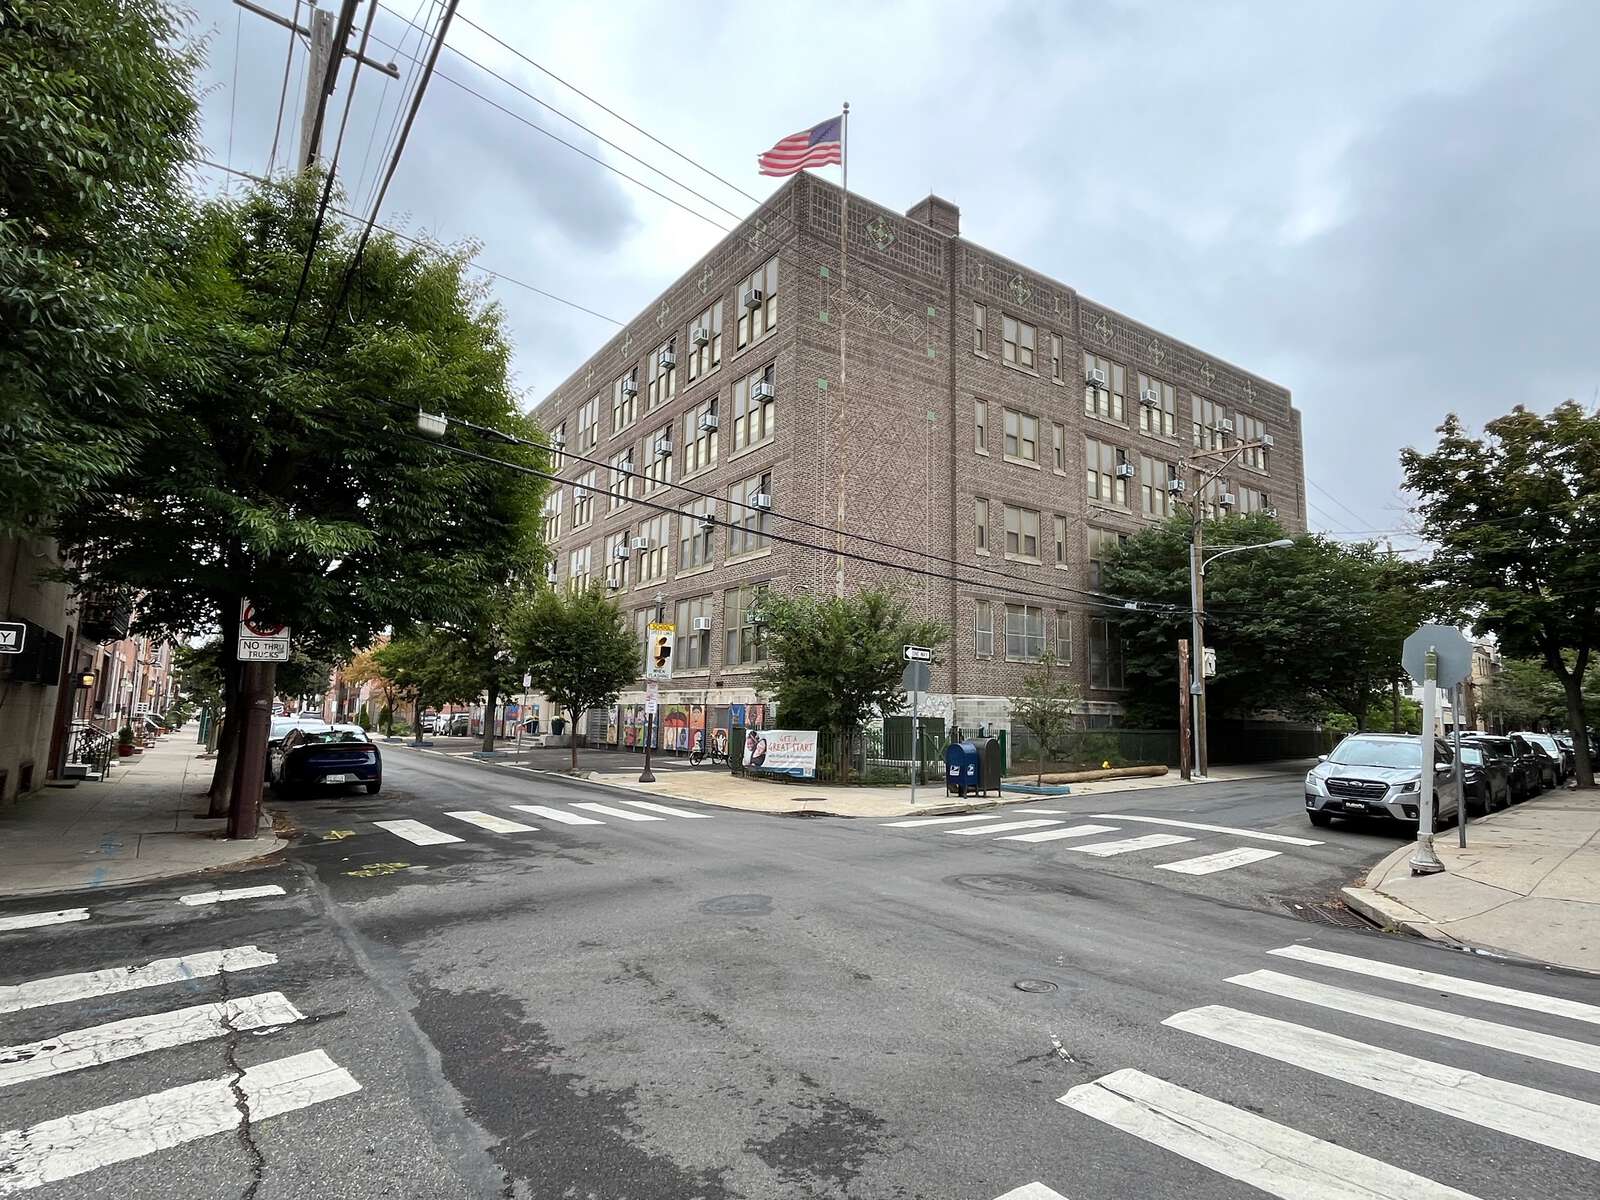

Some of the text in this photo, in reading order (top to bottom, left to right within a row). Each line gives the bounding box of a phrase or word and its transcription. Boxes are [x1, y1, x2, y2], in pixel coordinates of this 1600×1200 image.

[243, 641, 285, 651] NO THRU
[768, 742, 814, 752] GREAT START
